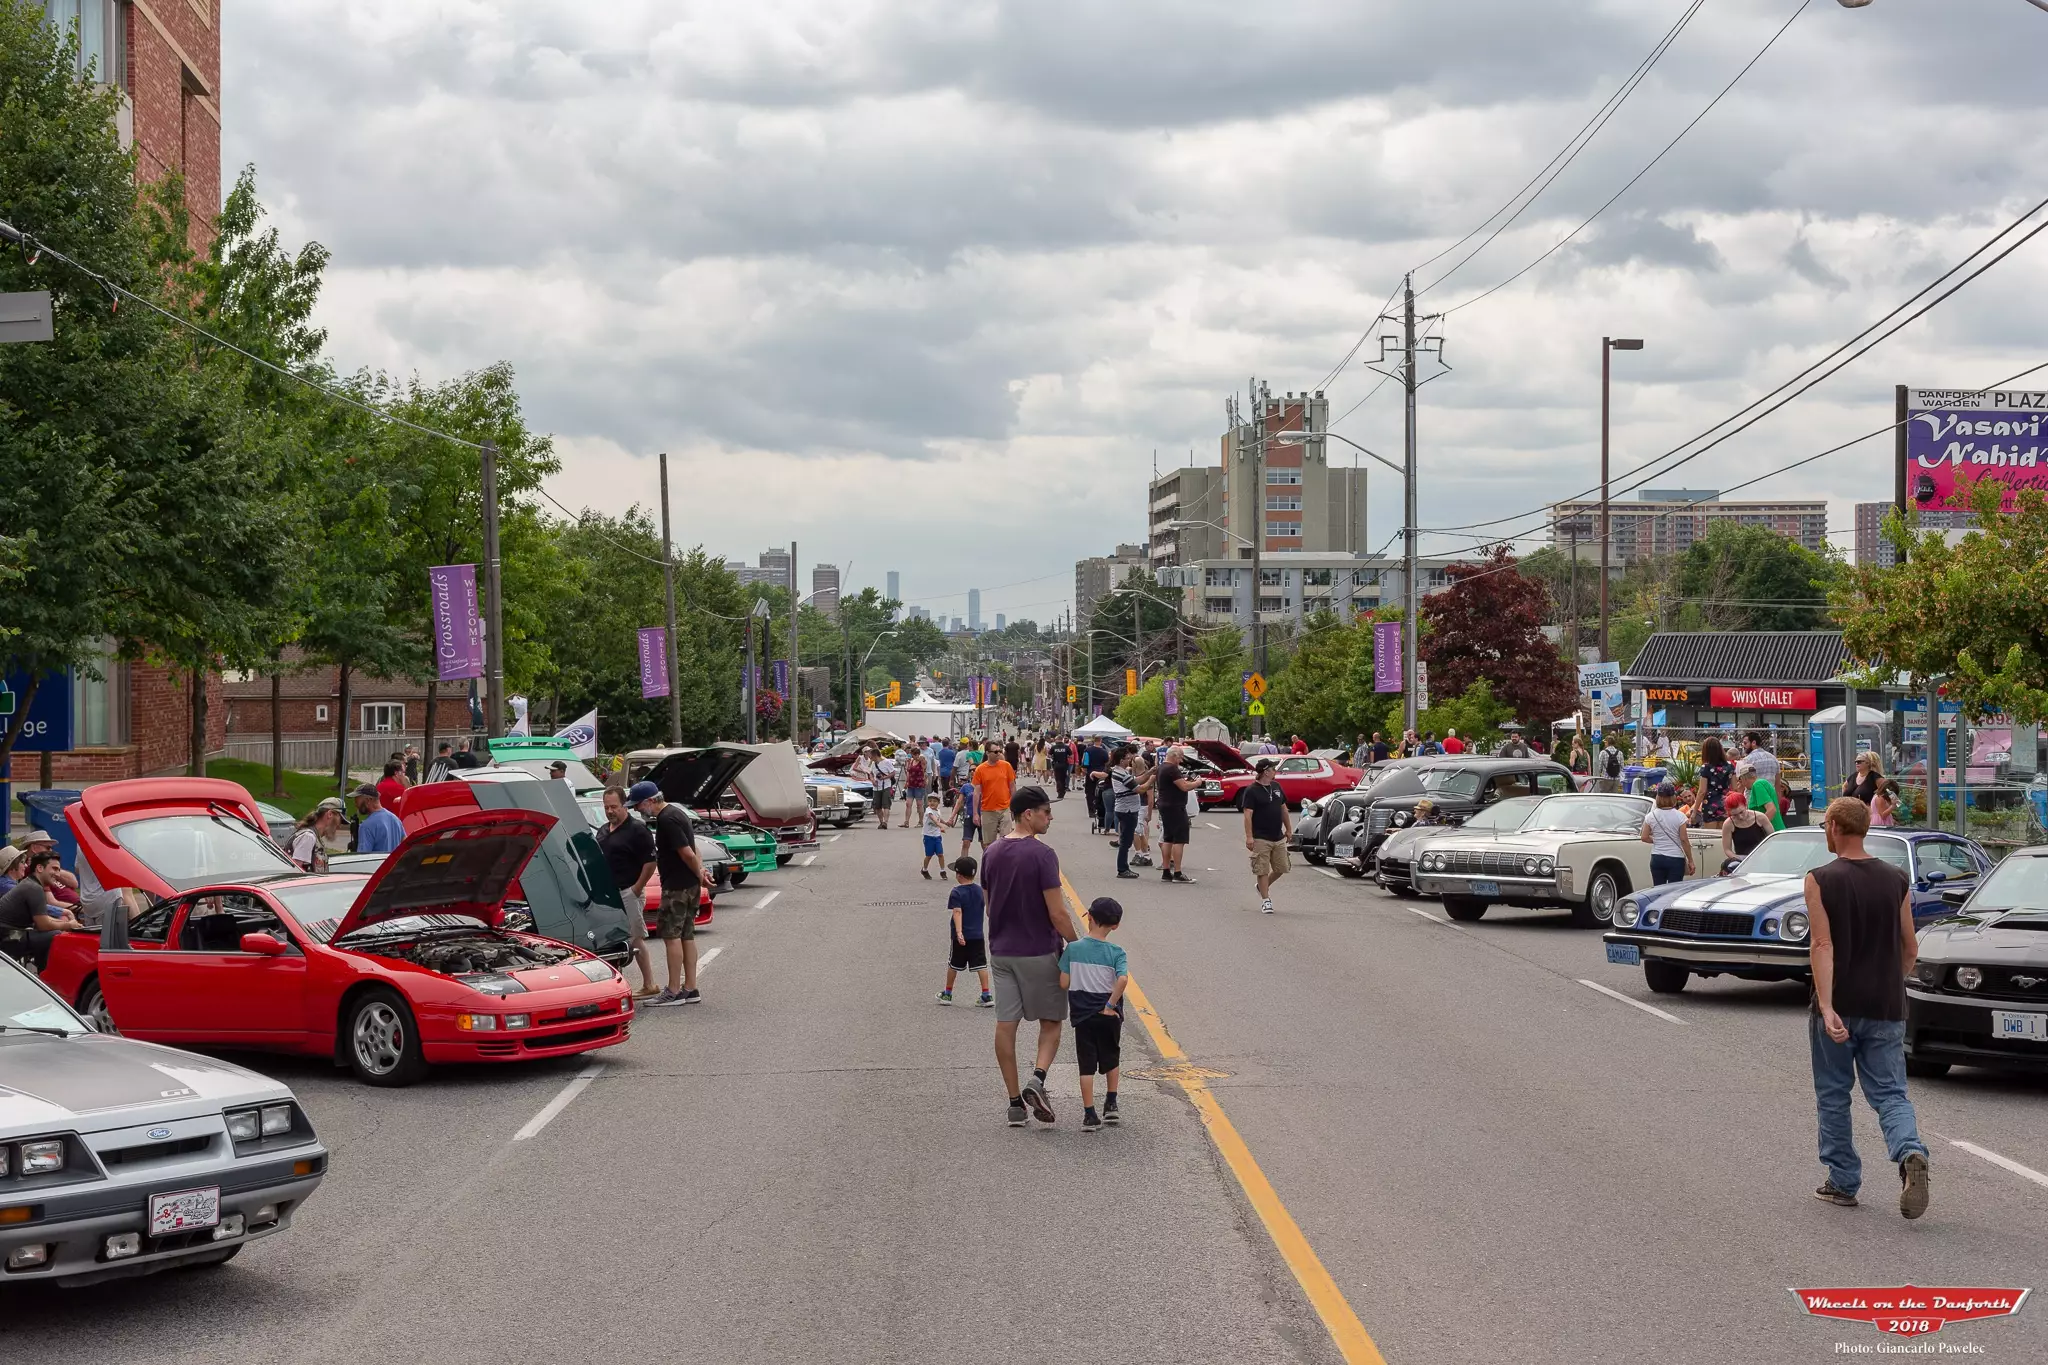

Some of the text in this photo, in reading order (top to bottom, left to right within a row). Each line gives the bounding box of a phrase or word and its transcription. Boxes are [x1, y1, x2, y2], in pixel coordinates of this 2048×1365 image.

[1918, 391, 1987, 399] DANFORTH
[1994, 392, 2048, 409] PLAZ
[1922, 399, 1980, 407] WARDEN
[432, 573, 456, 659] Crossroads
[464, 579, 478, 646] WELCOME
[639, 632, 654, 686] Crossroads
[1374, 627, 1387, 680] Crossroads
[1580, 677, 1619, 688] SHAKES
[1584, 671, 1615, 680] TOONIE
[1731, 688, 1793, 707] SWISS CHALET
[1608, 949, 1638, 961] CAMARO77
[2003, 1019, 2035, 1034] DWB 1
[160, 1088, 190, 1098] GT
